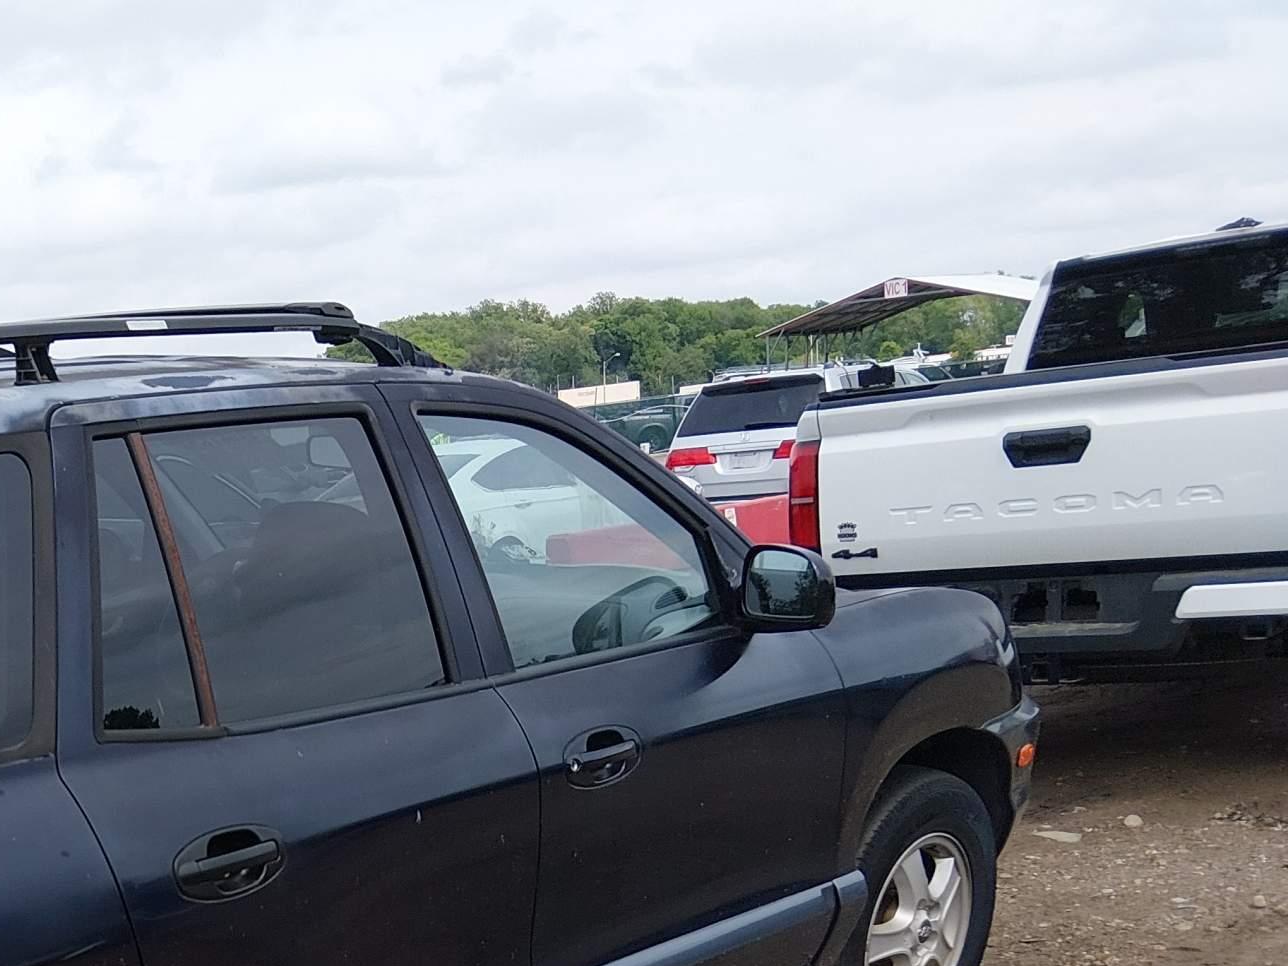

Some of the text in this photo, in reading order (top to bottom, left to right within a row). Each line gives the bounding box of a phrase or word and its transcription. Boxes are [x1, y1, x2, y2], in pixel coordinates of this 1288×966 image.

[885, 279, 907, 296] VIC 1
[889, 484, 1224, 525] TACOMA
